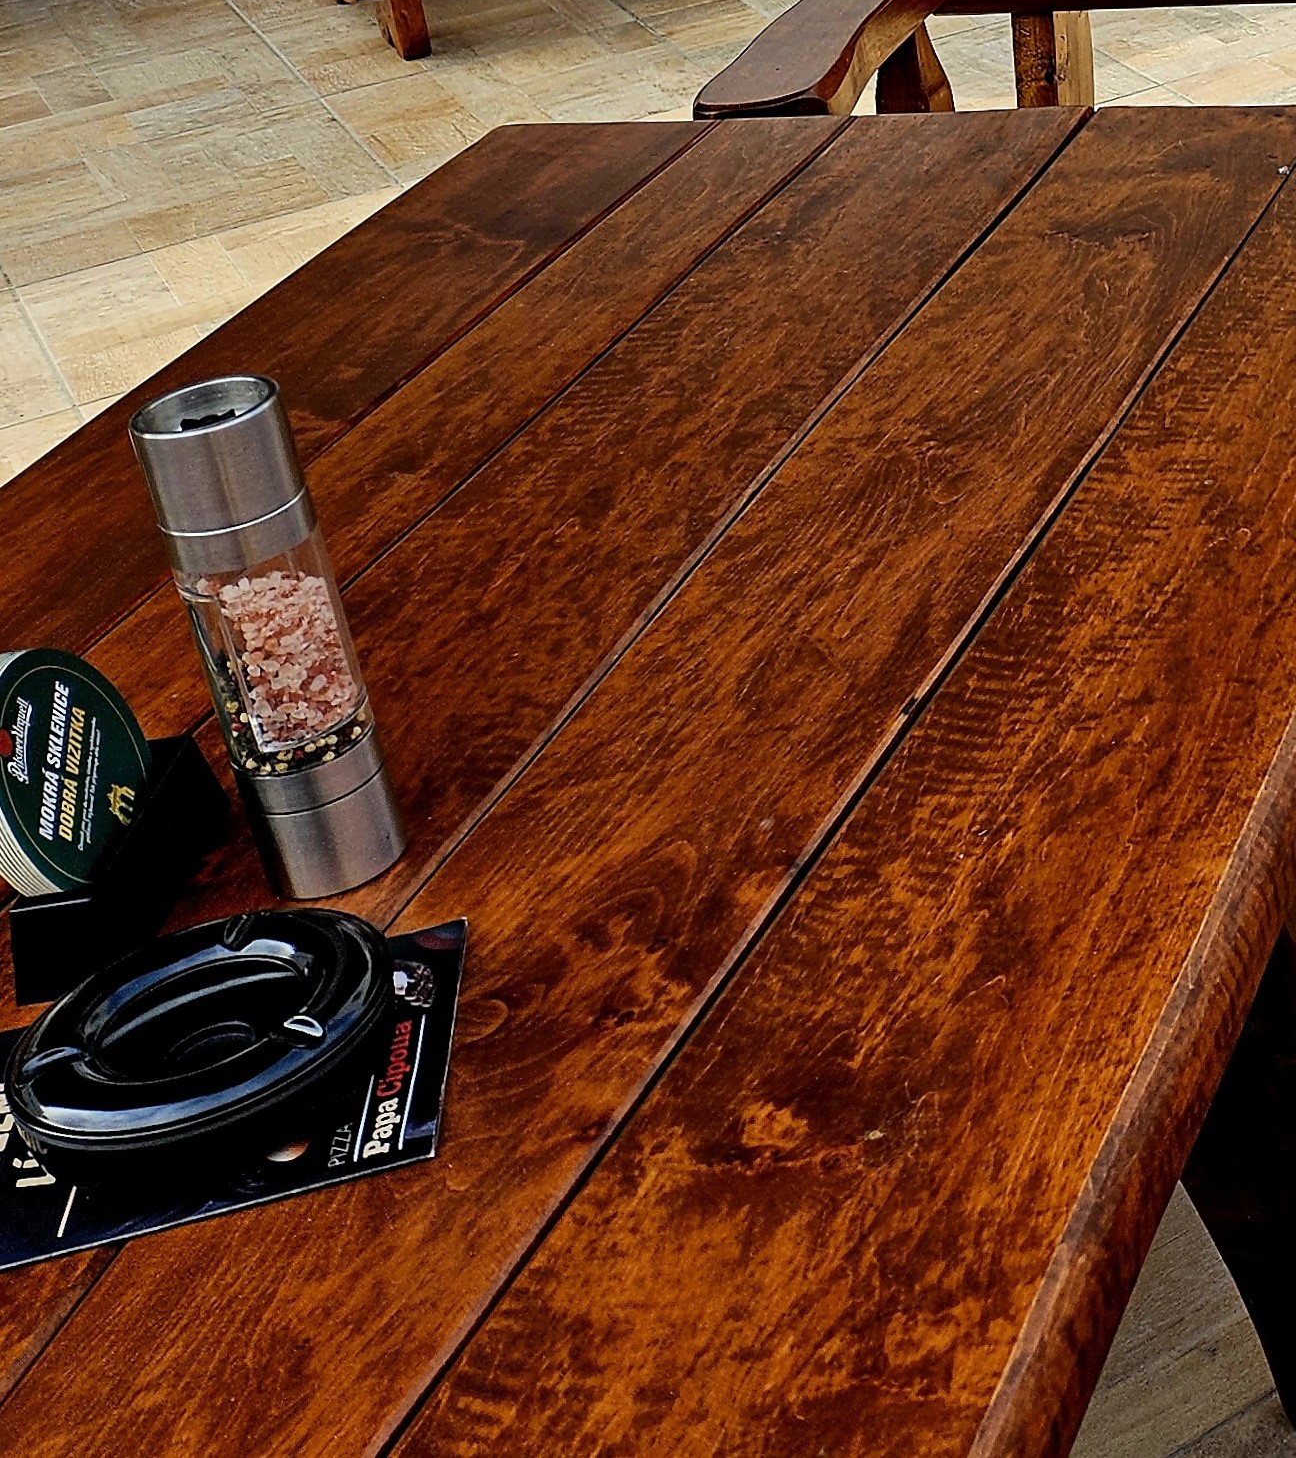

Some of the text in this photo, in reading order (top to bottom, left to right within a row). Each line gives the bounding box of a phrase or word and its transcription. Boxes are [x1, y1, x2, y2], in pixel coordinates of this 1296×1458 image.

[7, 697, 32, 784] Pilsner Urquell
[39, 680, 70, 841] MOKRÁ SKLENICE
[58, 707, 86, 842] DOBRÁ VIZITKA
[328, 1123, 353, 1168] PIZZA
[363, 1098, 400, 1159] Papa
